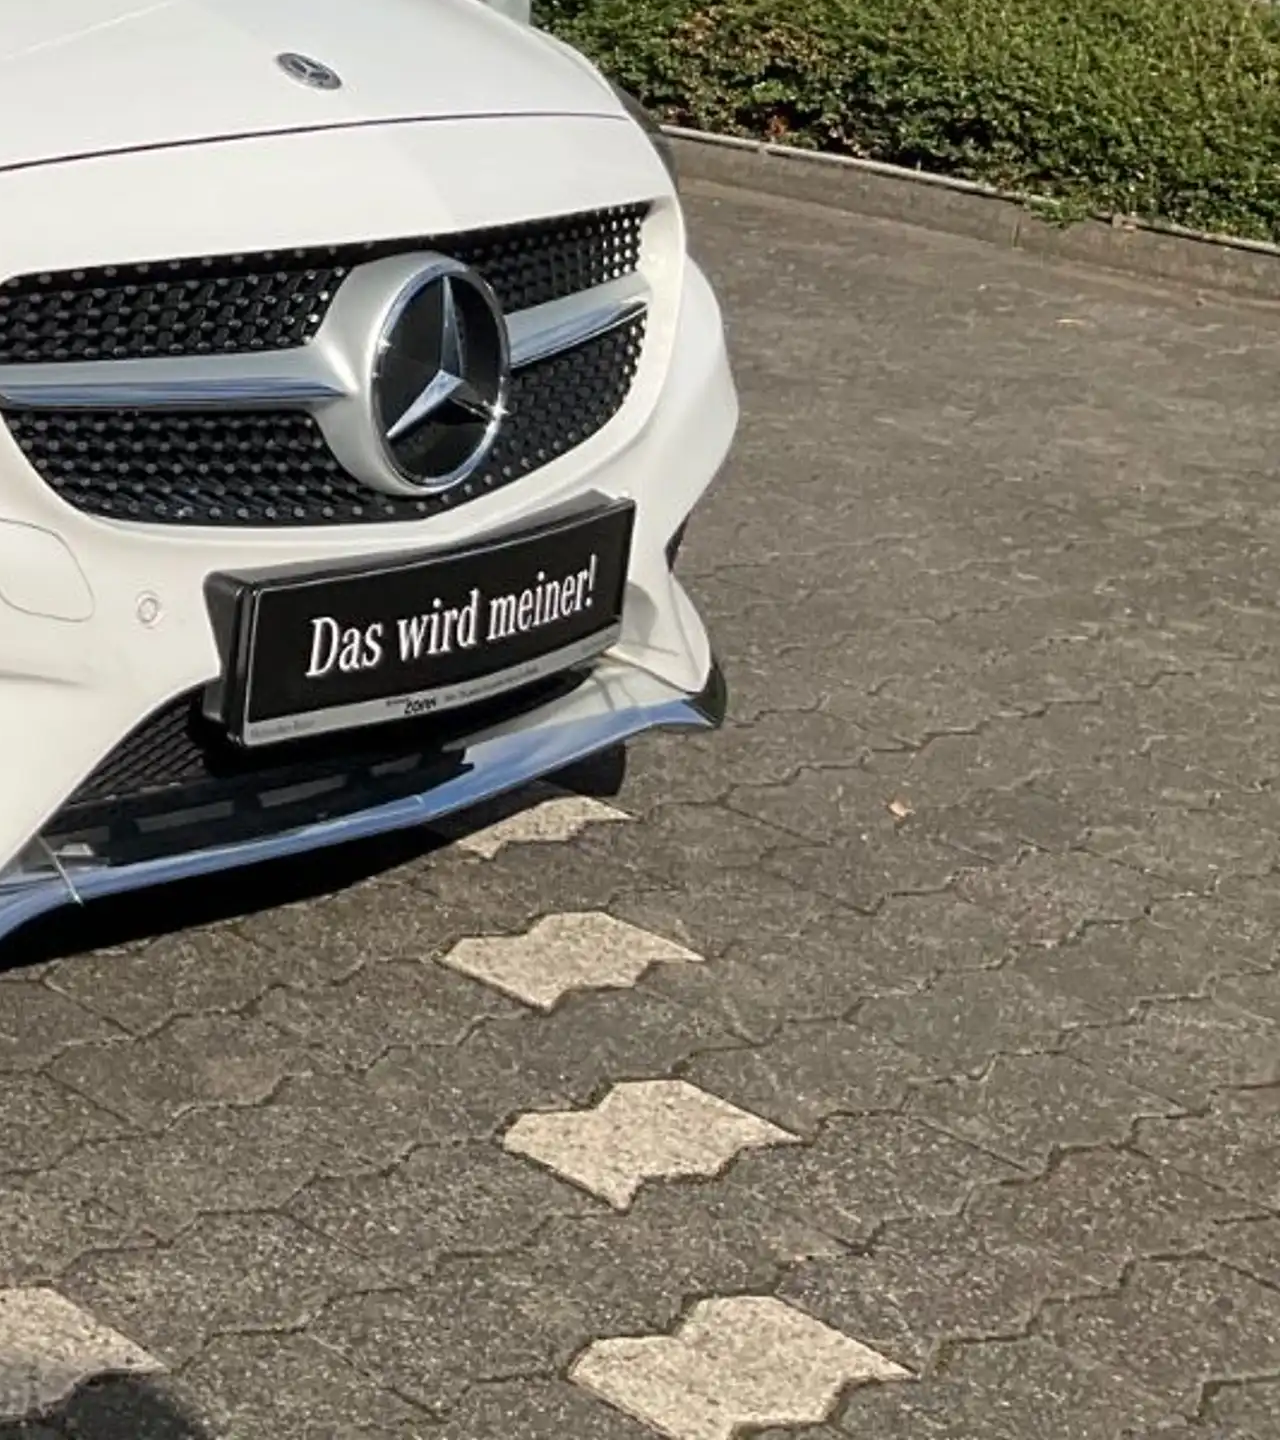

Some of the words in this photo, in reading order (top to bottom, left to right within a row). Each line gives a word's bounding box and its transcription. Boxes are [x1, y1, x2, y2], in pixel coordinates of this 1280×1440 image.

[305, 616, 383, 678] Das
[397, 588, 480, 662] wird
[486, 553, 597, 641] meiner!
